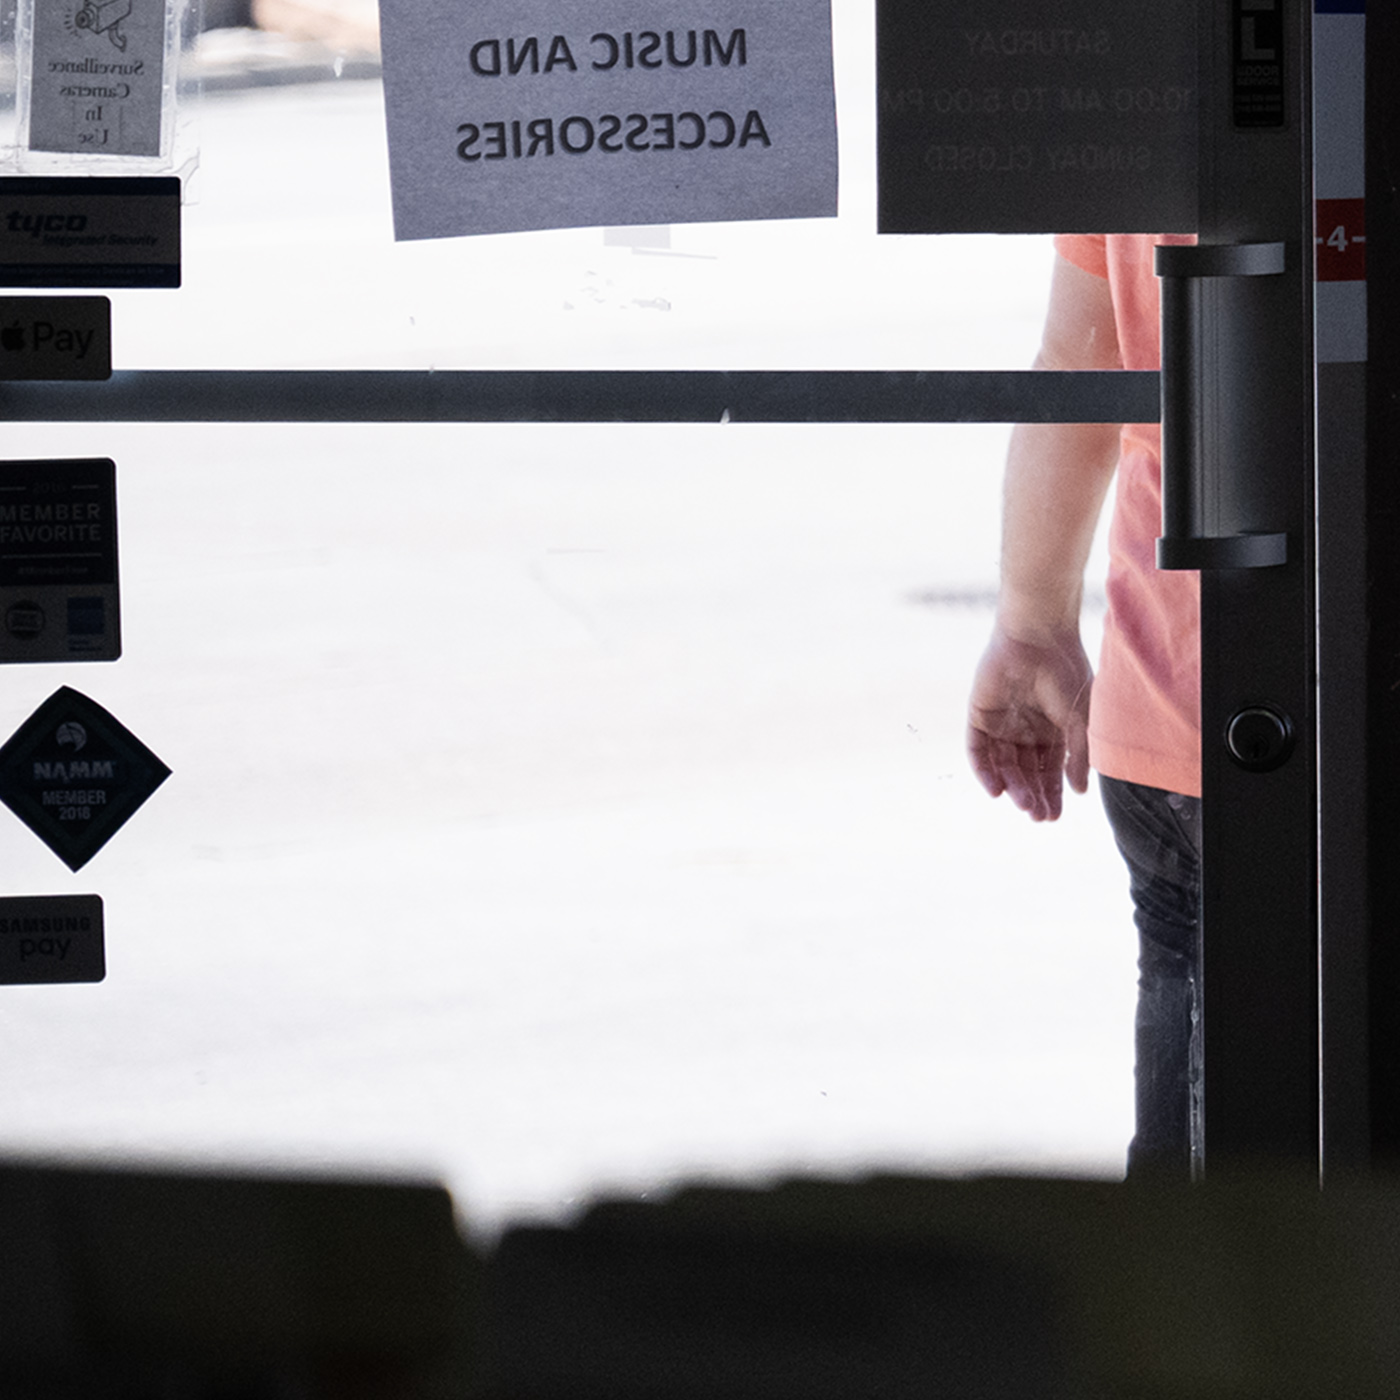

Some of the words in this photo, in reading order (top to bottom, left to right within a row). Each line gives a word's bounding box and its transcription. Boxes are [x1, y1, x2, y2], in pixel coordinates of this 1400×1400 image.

[6, 210, 88, 238] tyco
[107, 233, 158, 247] Security
[32, 321, 95, 358] Pay
[0, 502, 101, 522] MEMBER
[0, 523, 102, 544] FAVORITE
[42, 789, 106, 806] MEMBER
[0, 916, 91, 934] SAMSUNG
[19, 937, 72, 962] pay
